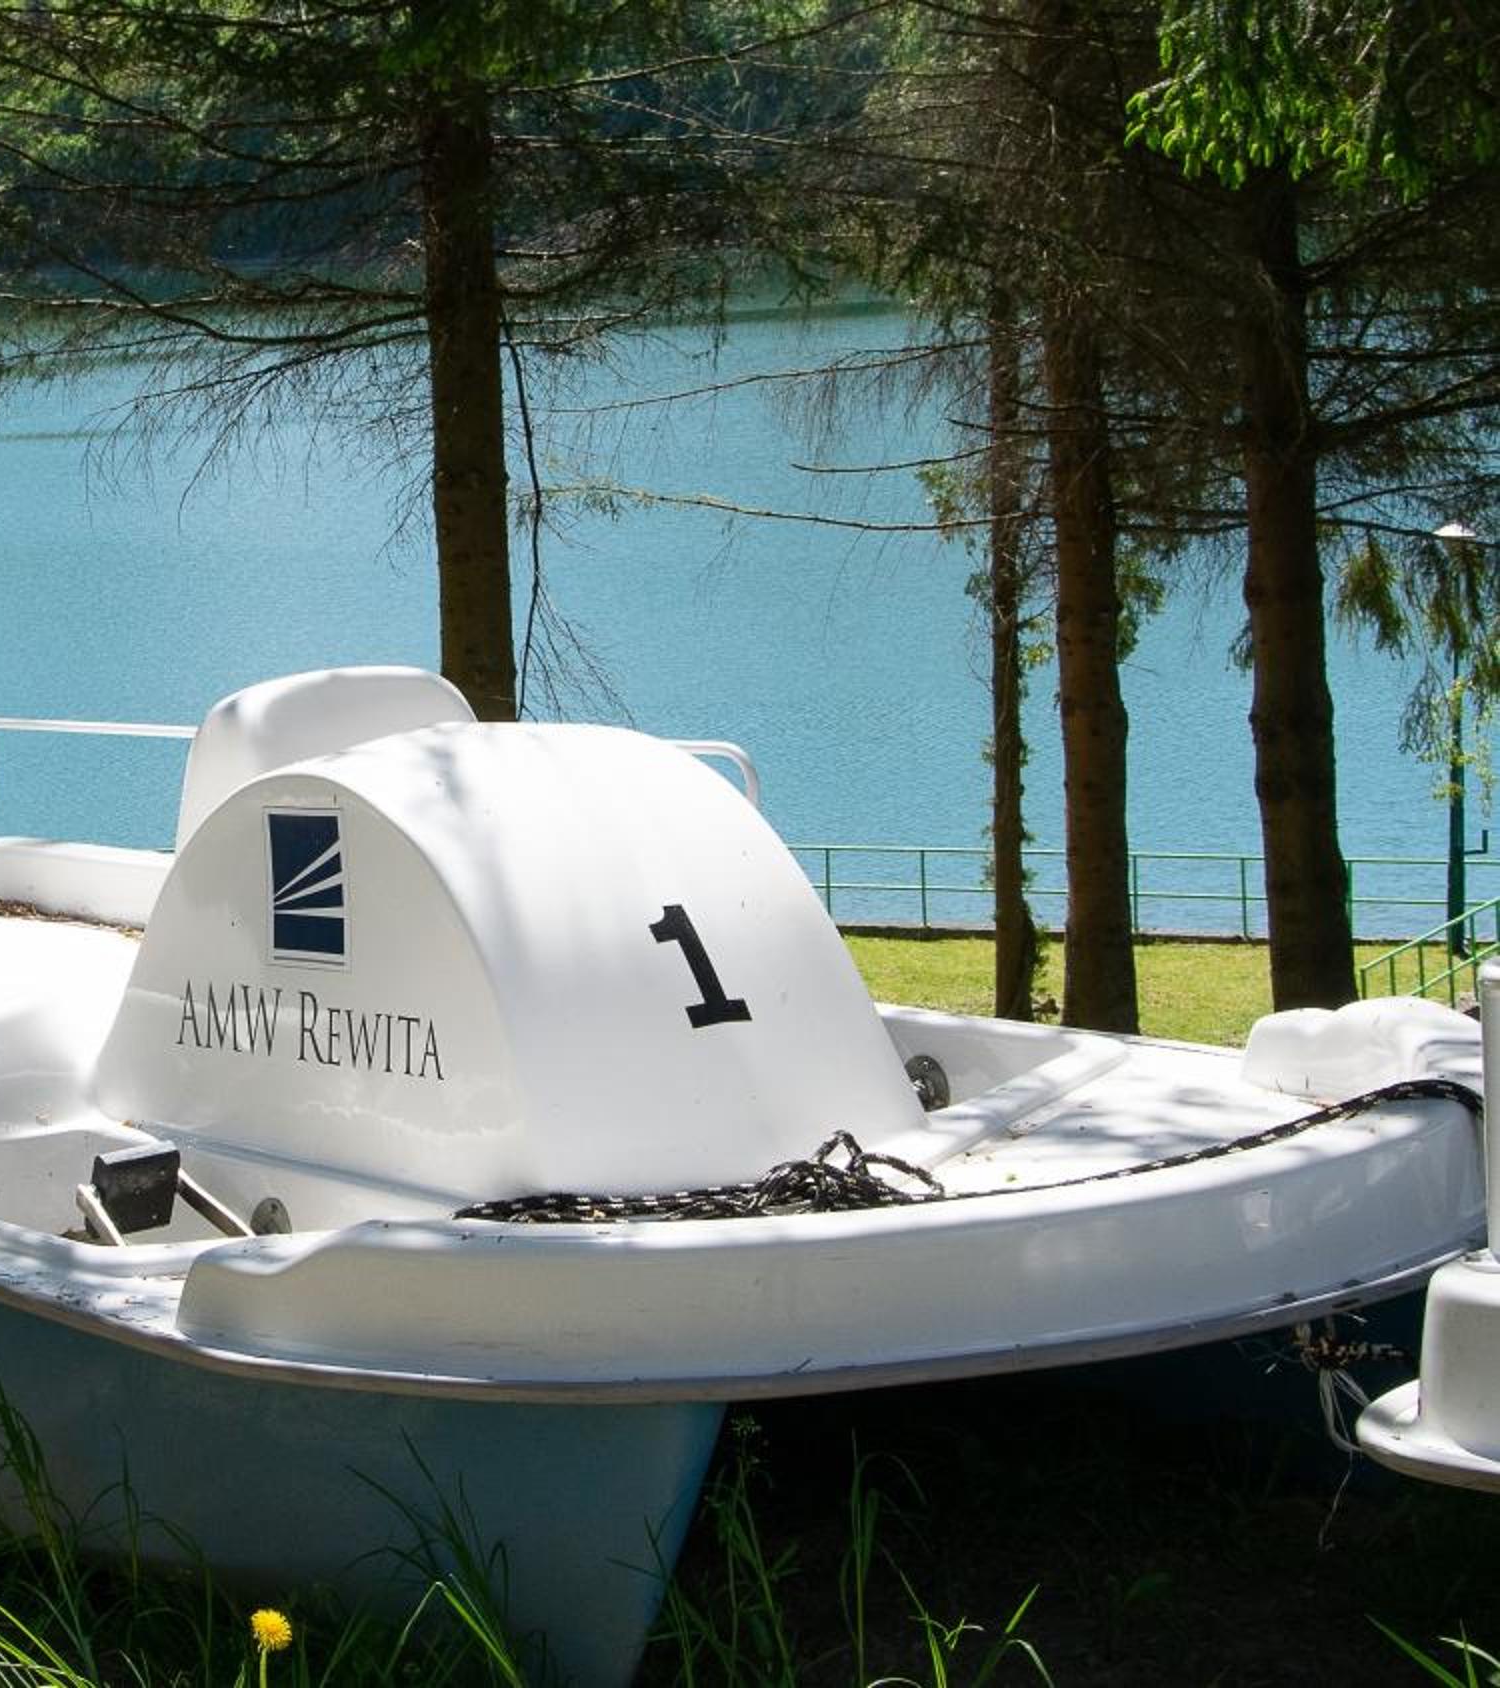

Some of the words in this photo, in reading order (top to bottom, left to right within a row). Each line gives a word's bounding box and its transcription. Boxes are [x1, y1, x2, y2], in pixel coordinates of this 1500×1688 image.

[649, 904, 752, 1028] 1
[177, 979, 281, 1056] AMW
[297, 990, 445, 1080] REWITA
